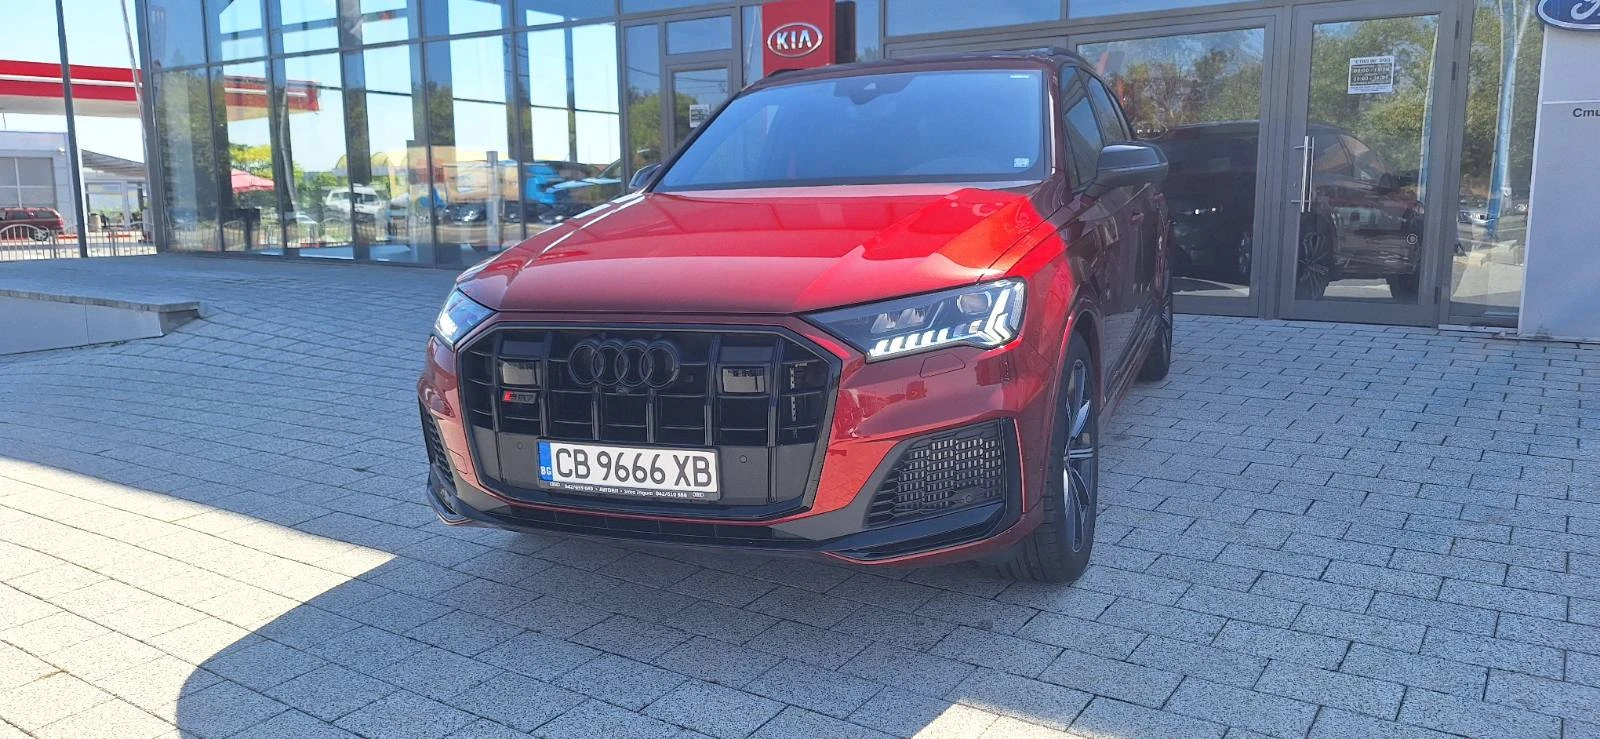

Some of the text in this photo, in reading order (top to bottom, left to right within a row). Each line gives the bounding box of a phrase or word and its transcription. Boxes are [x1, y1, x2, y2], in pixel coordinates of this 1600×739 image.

[776, 29, 812, 50] KIA
[540, 465, 552, 476] BG
[556, 448, 712, 487] CB 9666 XB
